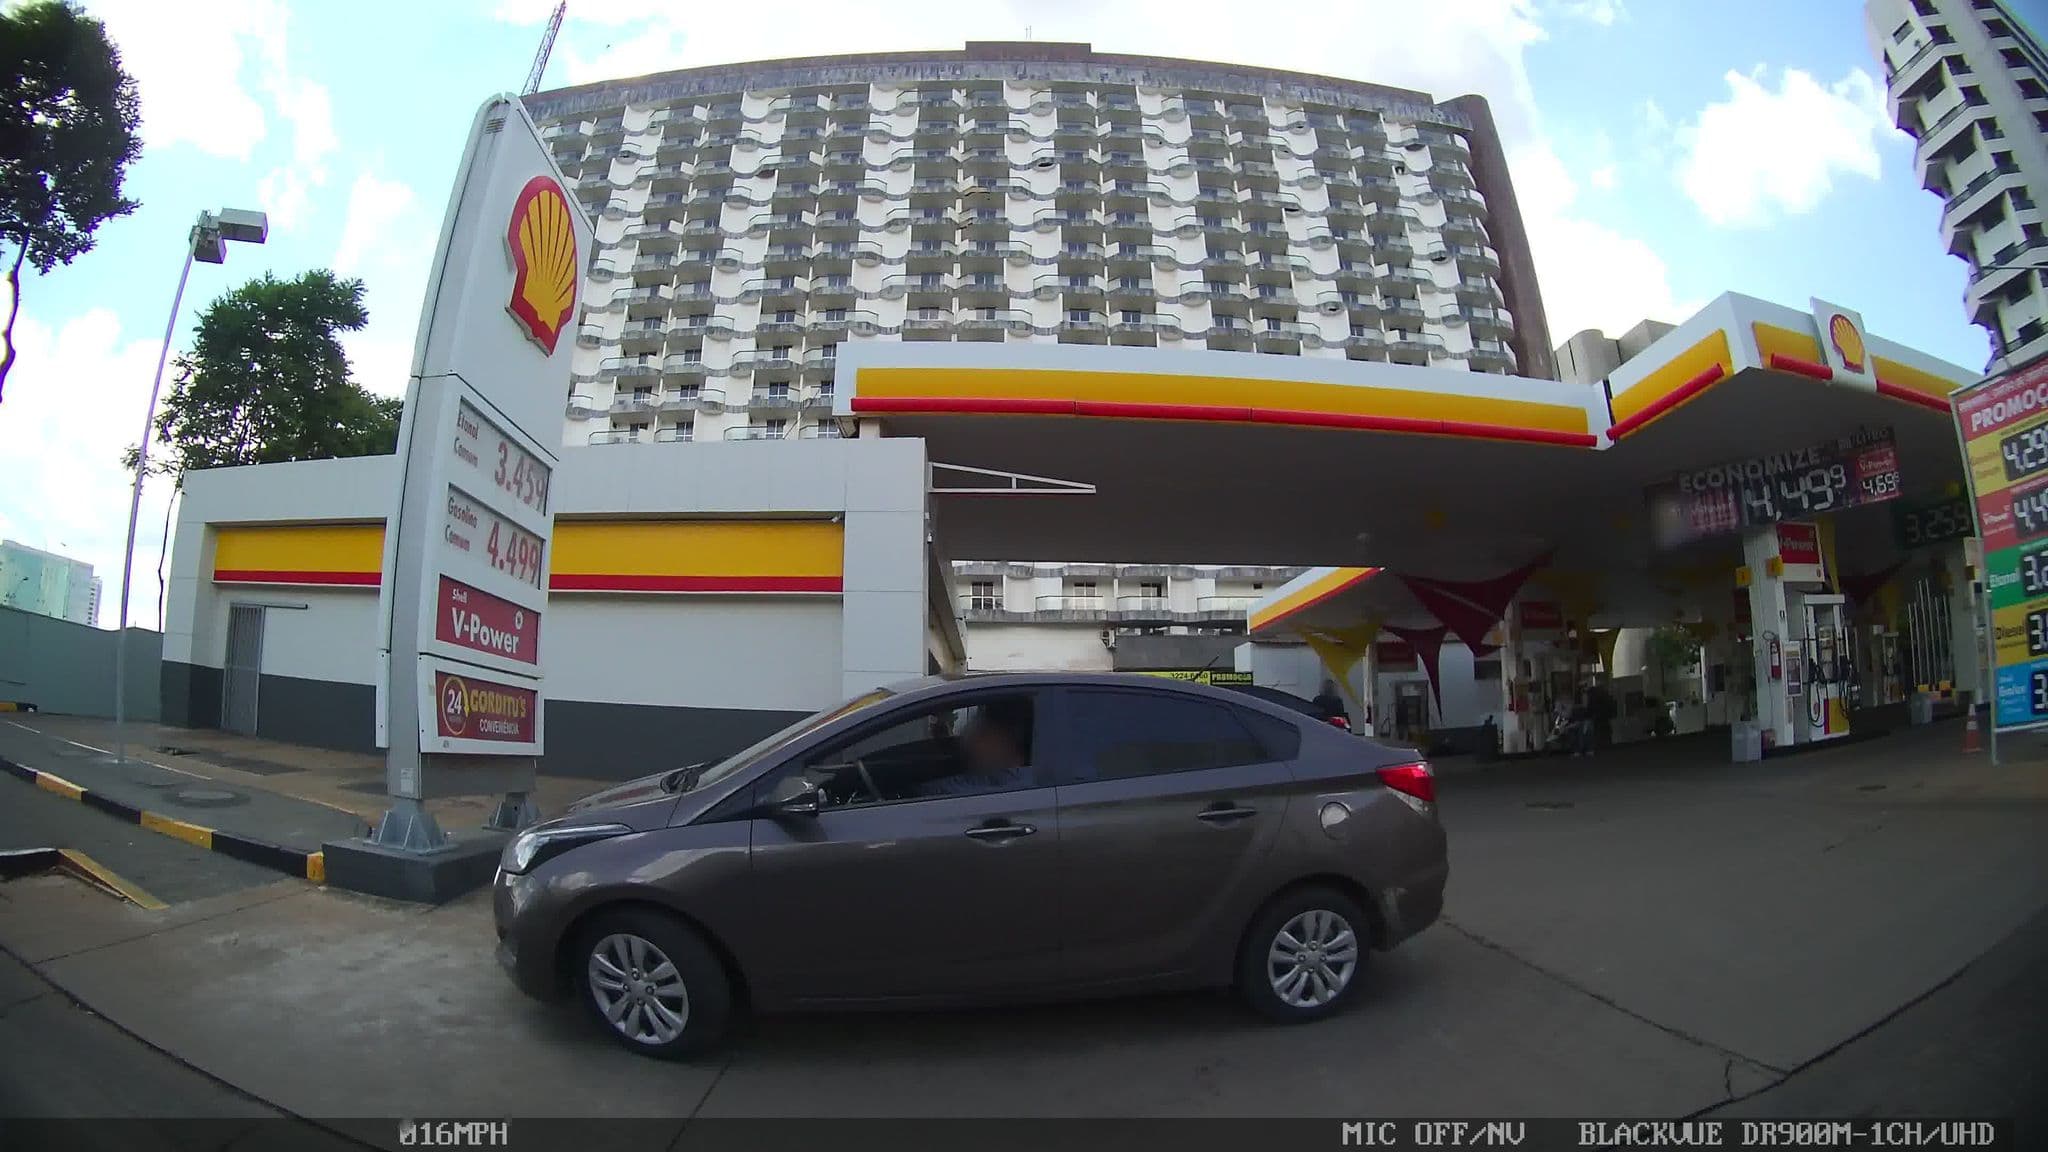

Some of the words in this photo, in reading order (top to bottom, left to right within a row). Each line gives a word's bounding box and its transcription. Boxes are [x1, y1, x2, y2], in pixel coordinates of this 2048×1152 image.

[487, 520, 539, 585] 4.499
[451, 606, 519, 654] V-Power
[447, 688, 462, 715] 24
